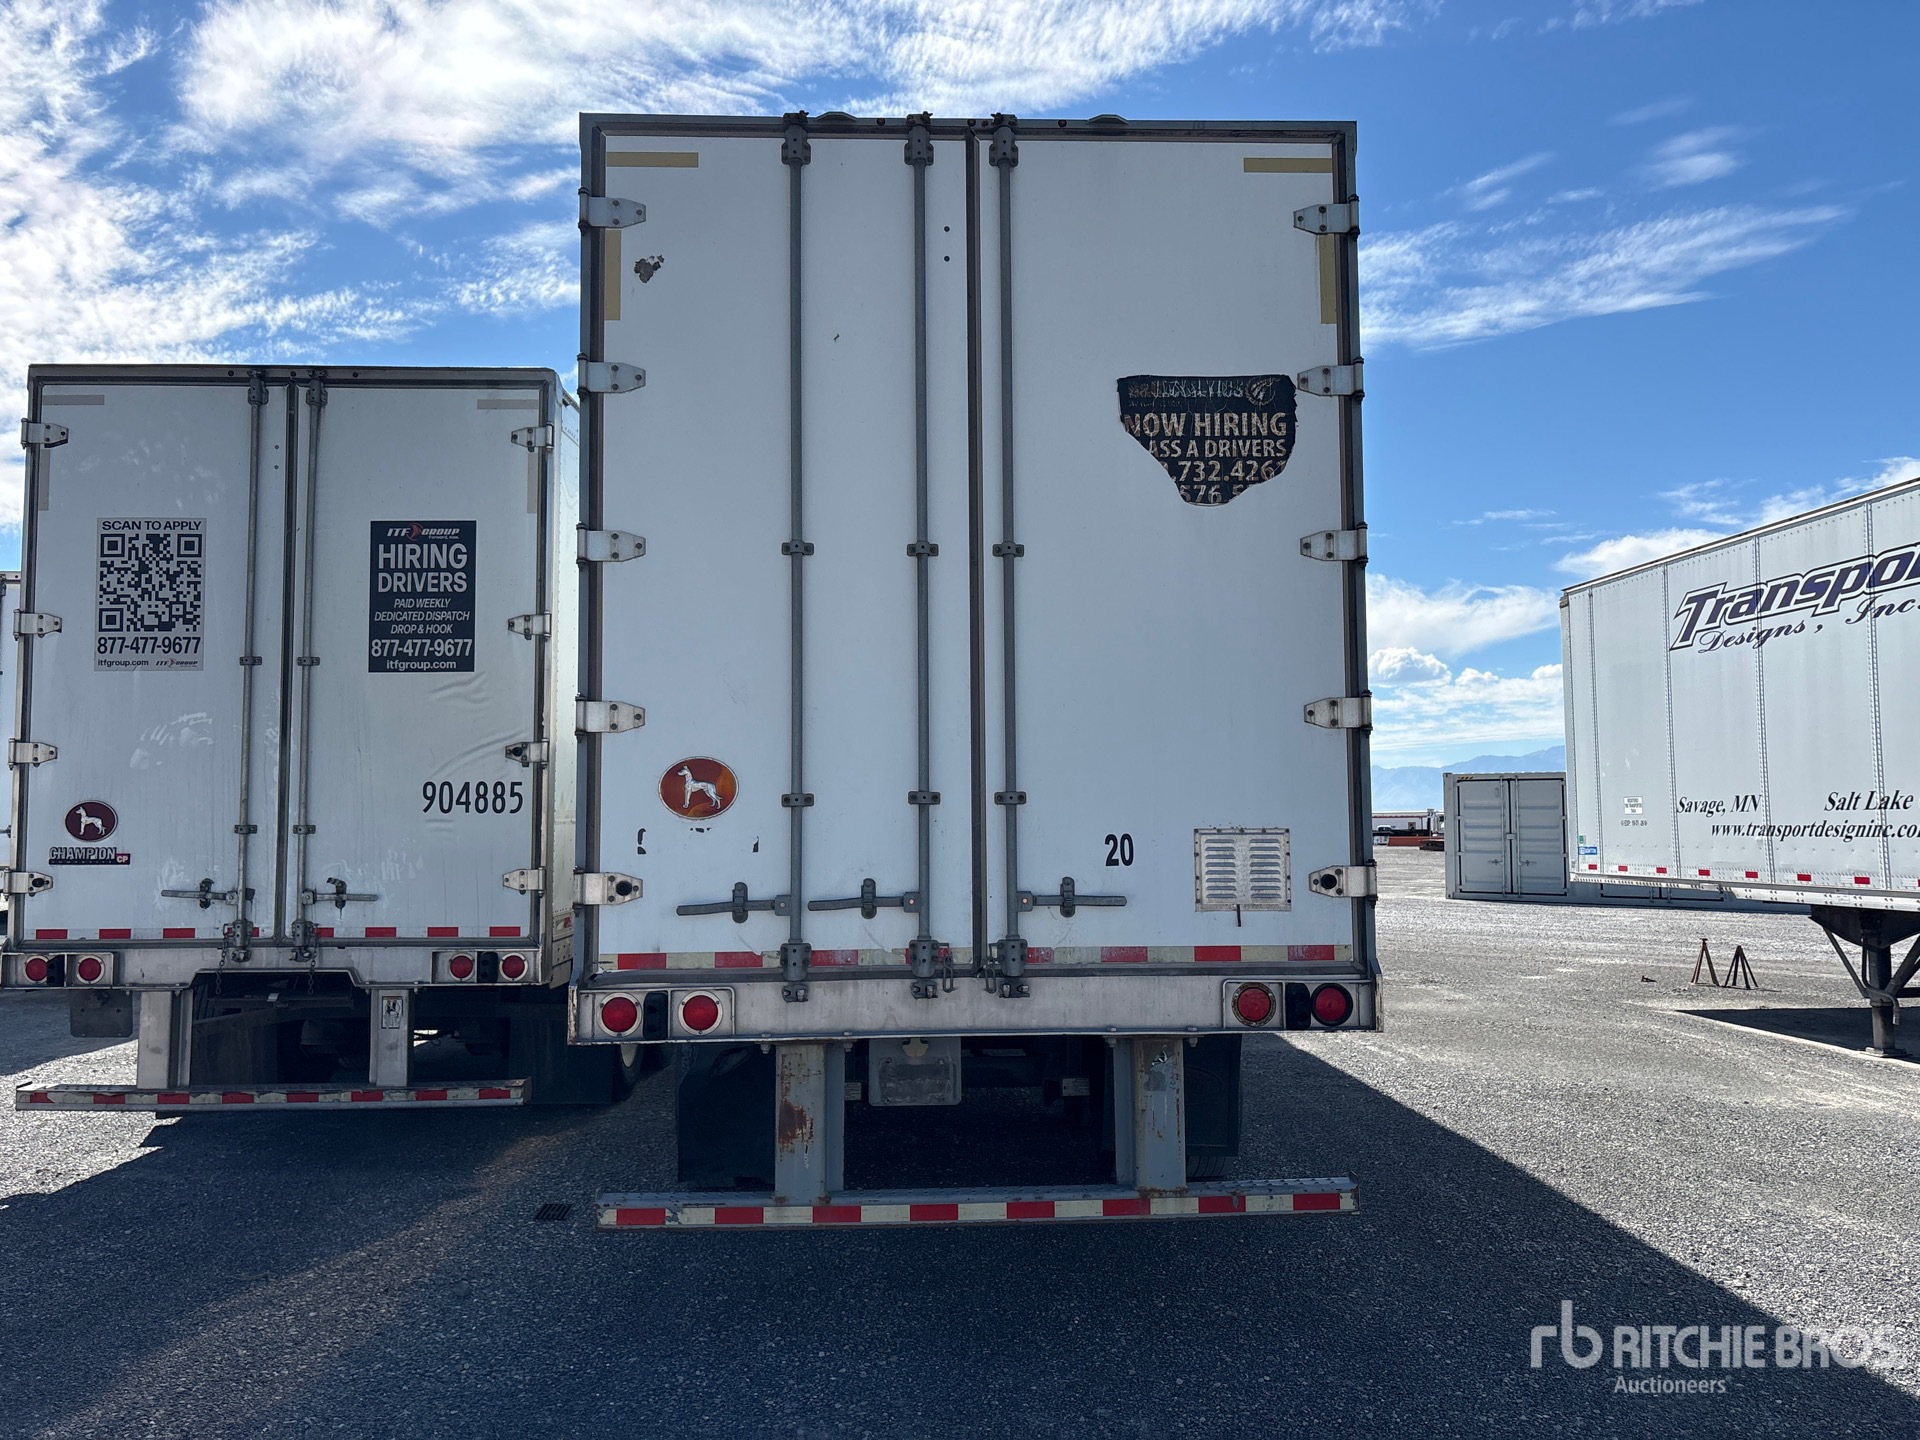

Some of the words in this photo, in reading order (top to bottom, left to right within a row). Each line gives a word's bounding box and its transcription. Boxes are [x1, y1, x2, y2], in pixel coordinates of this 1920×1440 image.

[1123, 412, 1187, 437] NOW
[1194, 412, 1287, 437] HIRING
[1186, 439, 1200, 458] A
[1204, 439, 1287, 458] DRIVERS
[102, 521, 142, 531] SCAN
[144, 521, 161, 531] TO
[163, 521, 201, 531] APPLY
[387, 528, 412, 537] ITF
[421, 528, 460, 536] GROUP
[378, 543, 468, 569] HIRING
[378, 571, 468, 593] DRIVERS
[393, 598, 415, 609] PAID
[416, 598, 451, 608] WEEKLY
[374, 611, 425, 621] DEDICATED
[425, 611, 470, 621] DISPATCH
[390, 624, 417, 634] DROP
[417, 624, 425, 634] &
[425, 624, 453, 634] HOOK
[96, 636, 201, 655] 877-477-9677
[371, 638, 473, 657] 877-477-9677
[97, 658, 149, 668] itfgroup.com
[386, 660, 457, 671] itfgroup.com
[422, 781, 523, 814] 904885
[1676, 796, 1726, 817] Savage,
[1730, 794, 1762, 813] MN
[1823, 791, 1861, 811] Salt
[1863, 790, 1914, 810] Lake
[1711, 820, 1920, 842] www.transportdesigninc.co
[49, 846, 117, 860] CHAMPION
[116, 855, 129, 863] CP
[1104, 833, 1134, 867] 20
